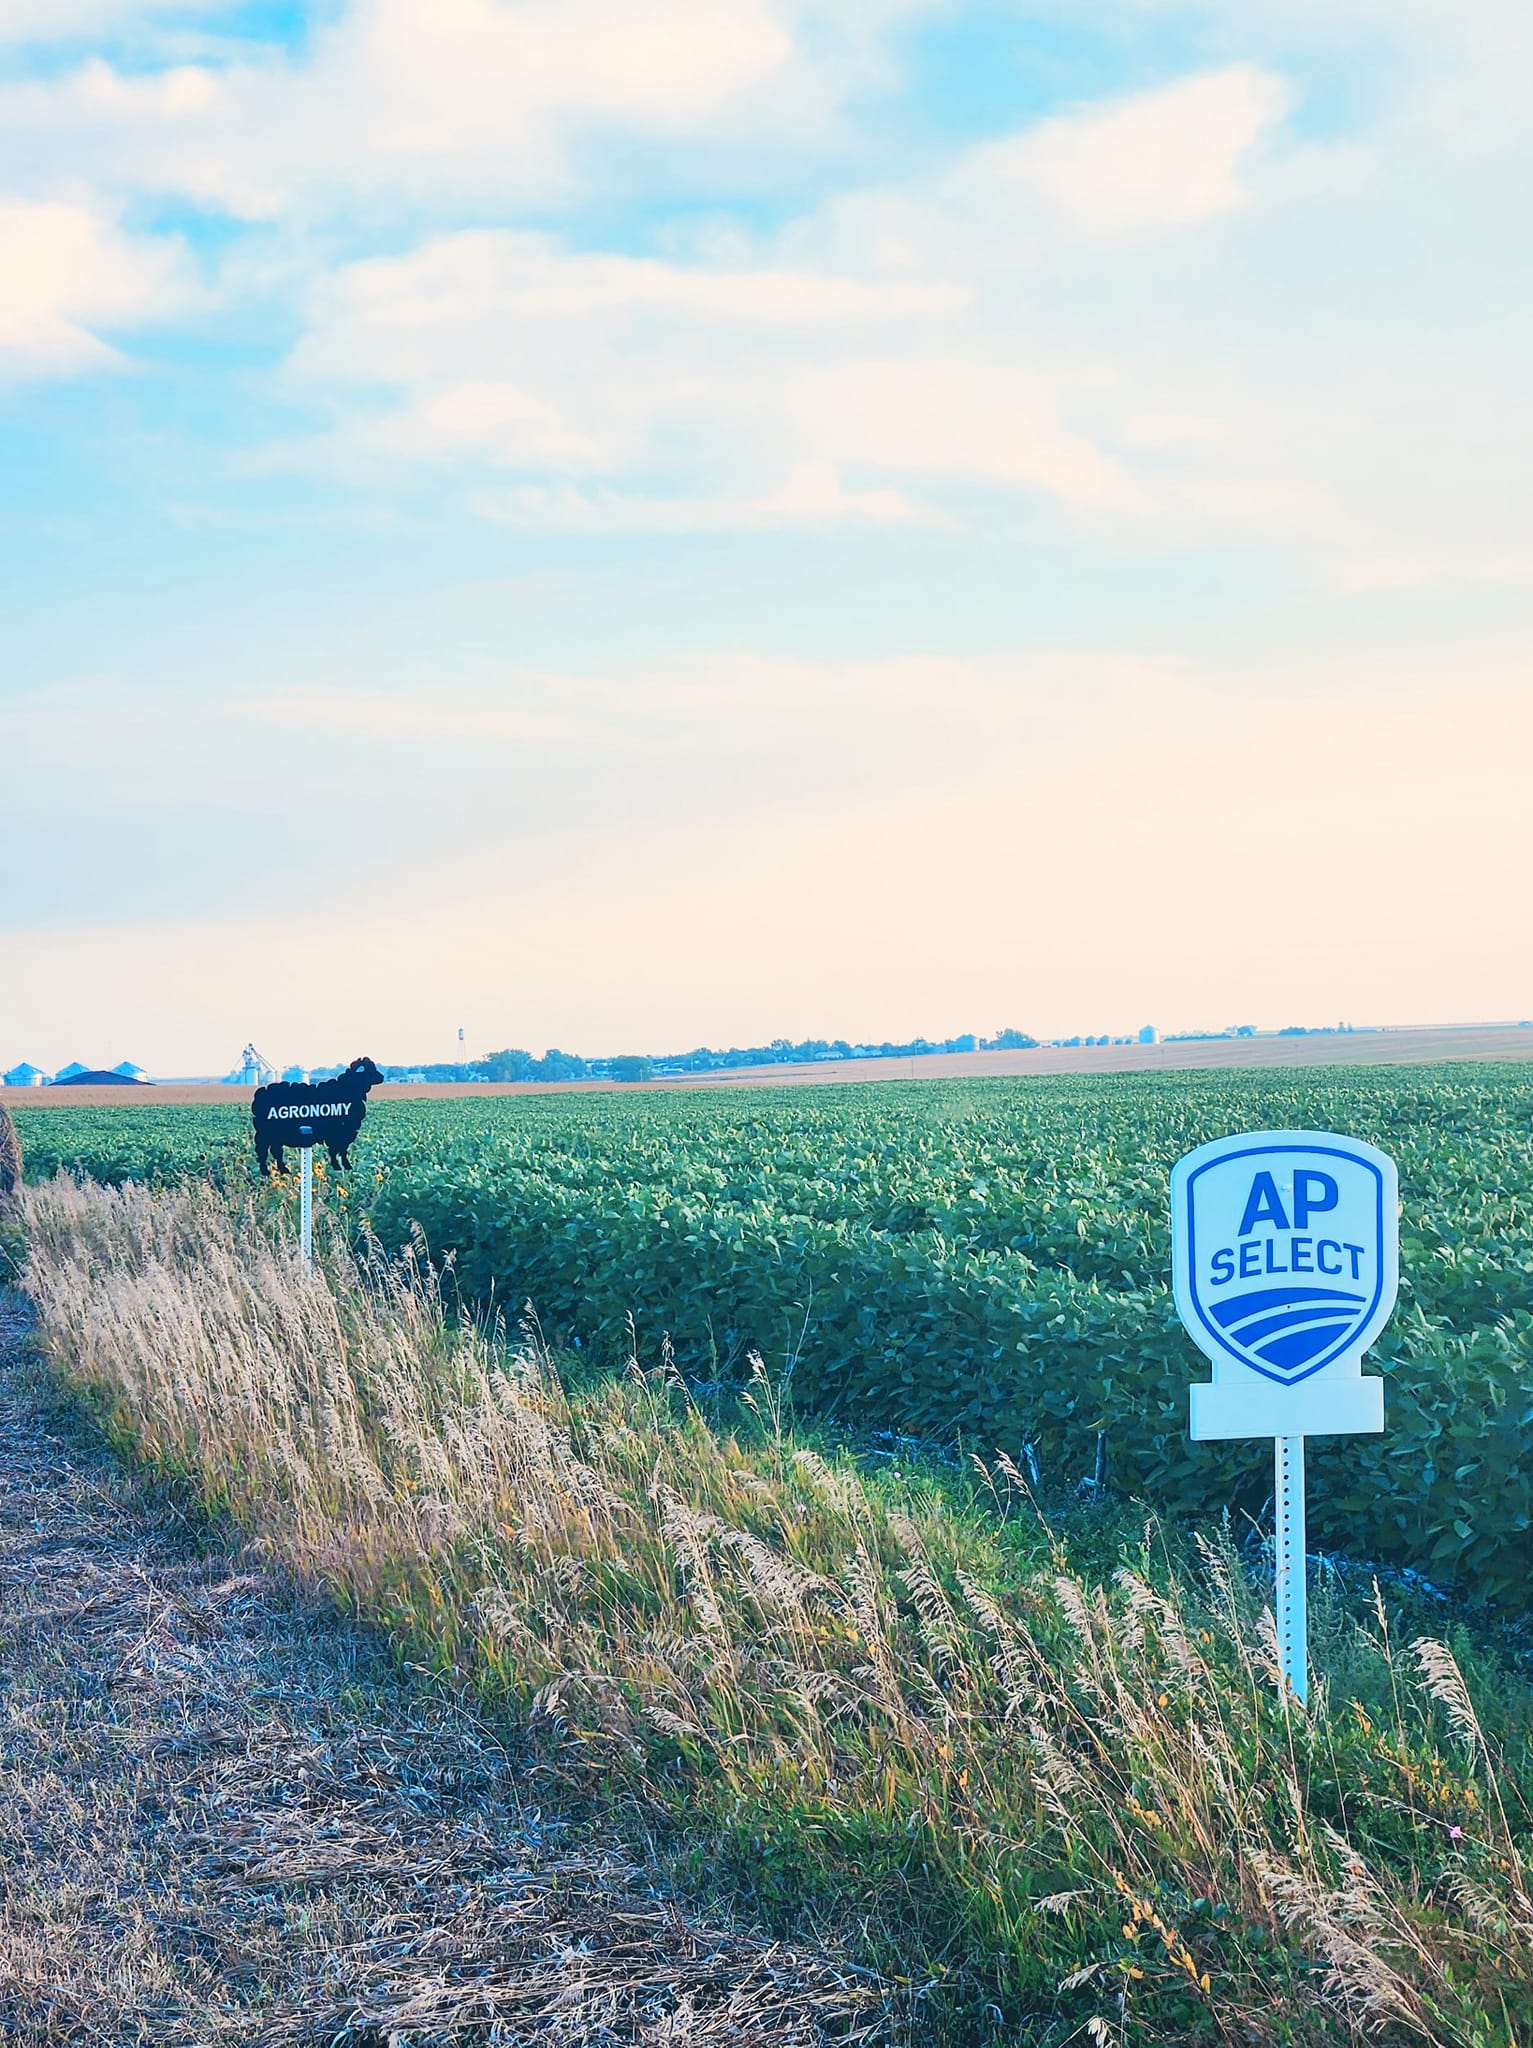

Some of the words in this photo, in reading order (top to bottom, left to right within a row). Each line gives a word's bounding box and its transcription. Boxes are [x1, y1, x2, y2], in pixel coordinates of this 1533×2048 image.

[267, 1102, 352, 1120] AGRONOMY
[1237, 1169, 1339, 1237] AP
[1210, 1237, 1365, 1286] SELECT
